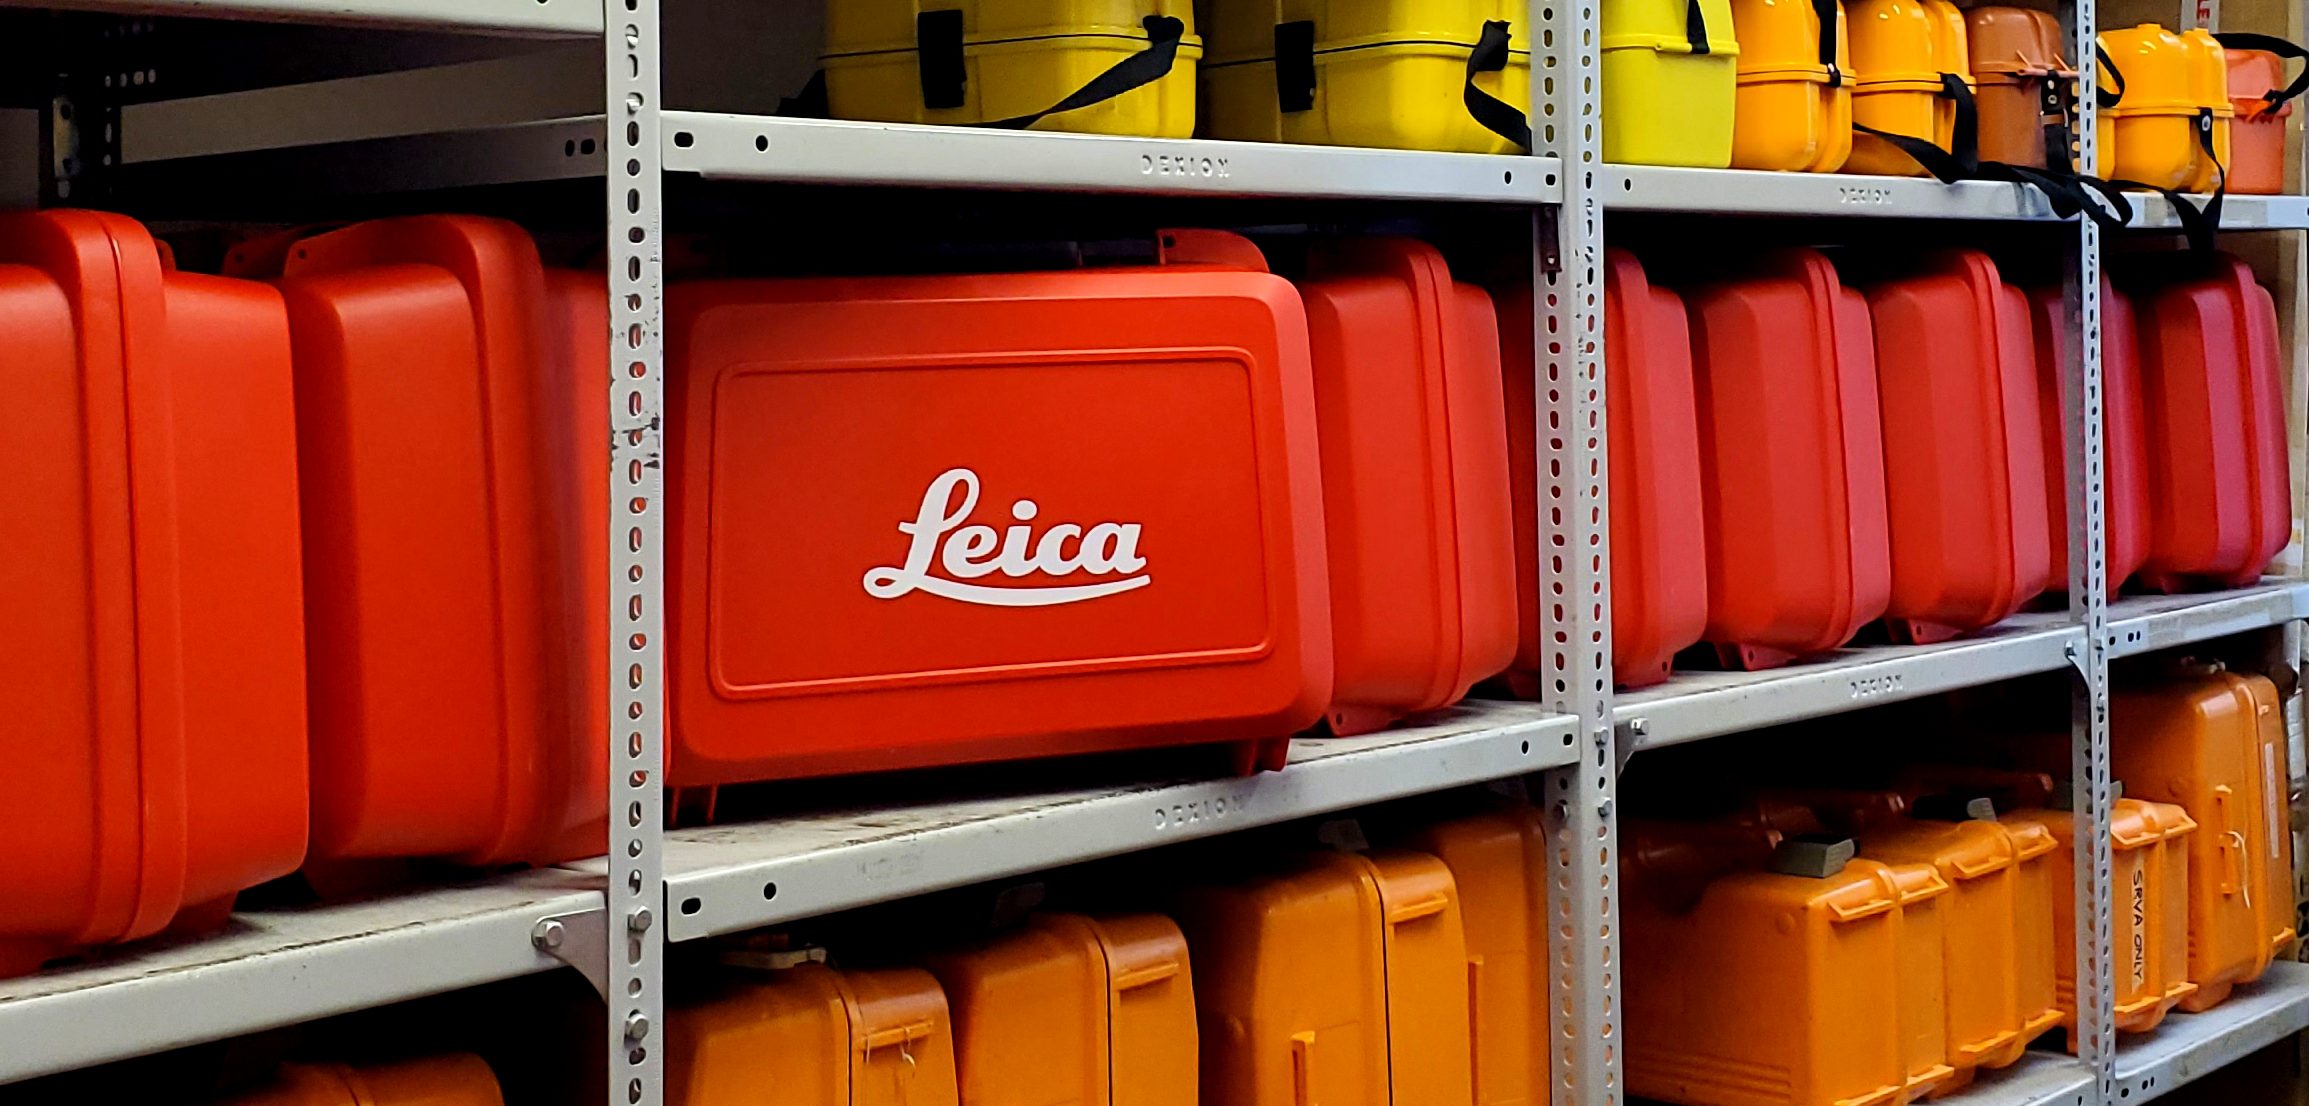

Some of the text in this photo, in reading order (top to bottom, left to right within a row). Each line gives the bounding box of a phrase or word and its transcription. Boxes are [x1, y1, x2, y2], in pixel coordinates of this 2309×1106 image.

[1141, 154, 1230, 178] DEXION
[863, 468, 1151, 606] Leica
[2133, 869, 2143, 979] SRVA ONLY
